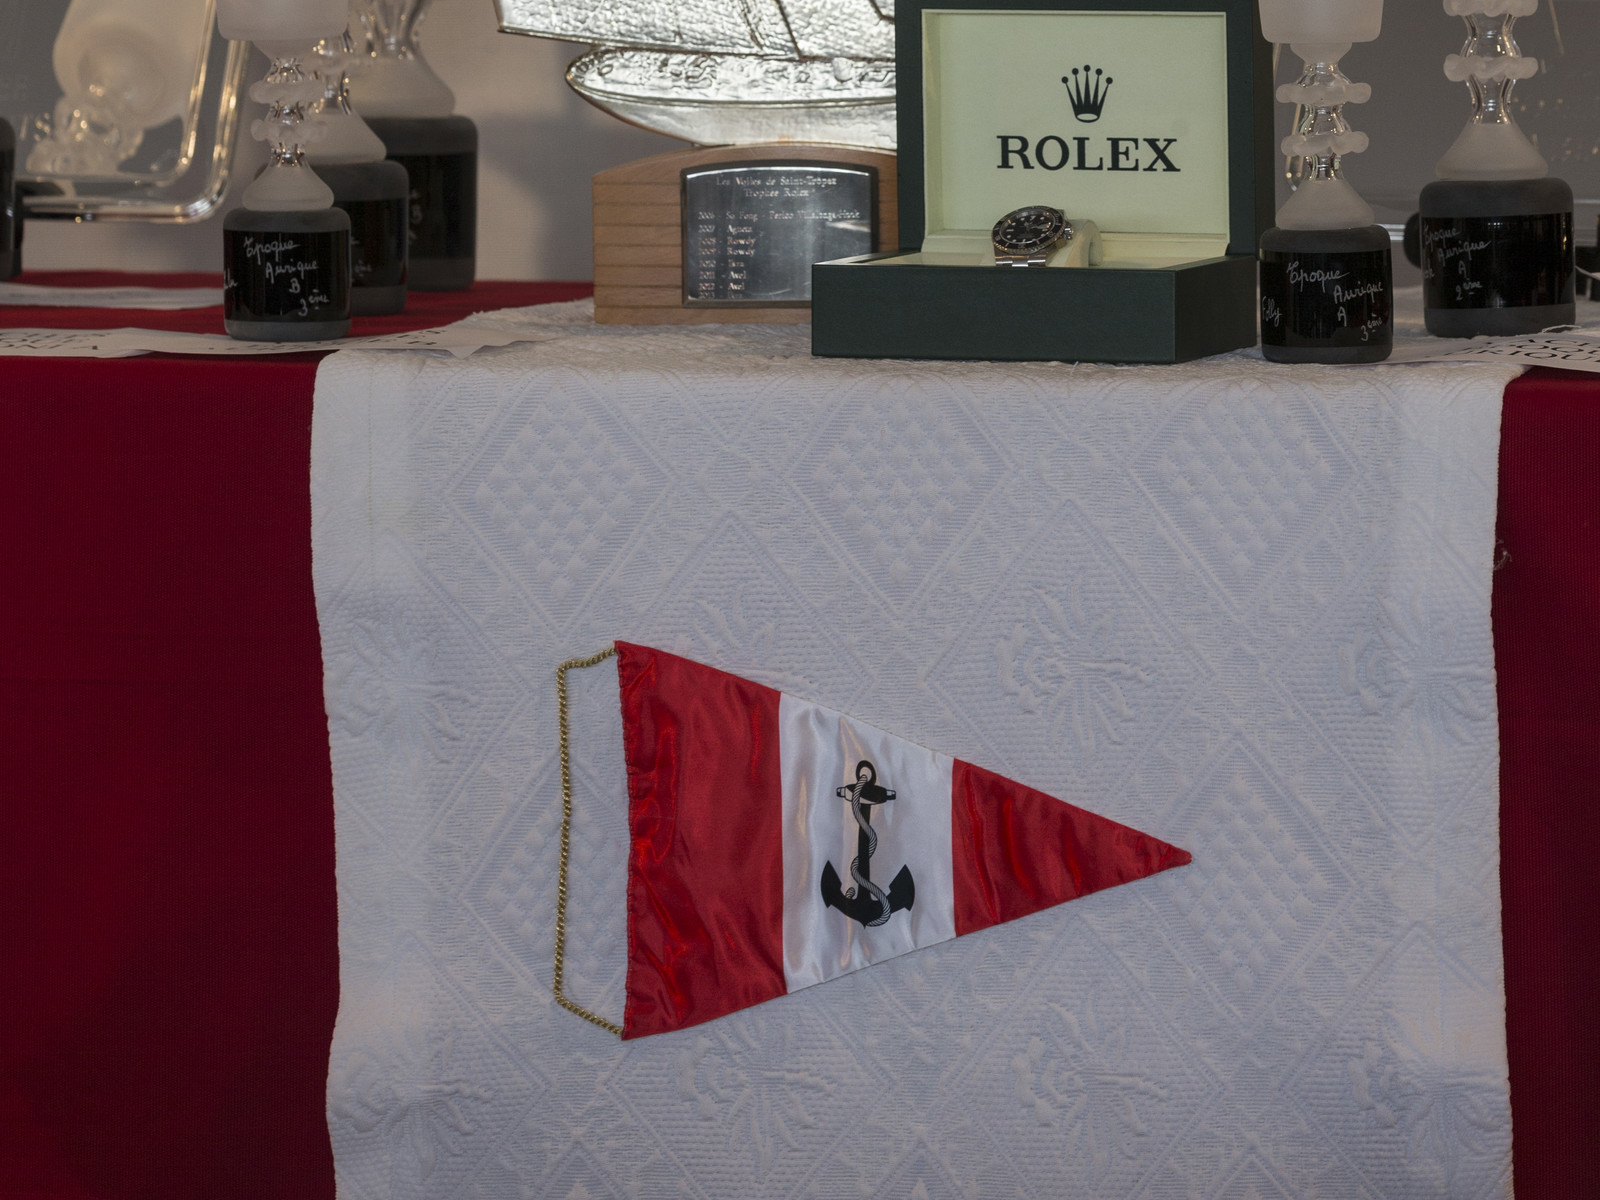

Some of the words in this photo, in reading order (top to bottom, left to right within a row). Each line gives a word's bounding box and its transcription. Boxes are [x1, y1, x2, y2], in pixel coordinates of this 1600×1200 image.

[996, 135, 1181, 172] ROLEX
[288, 277, 301, 294] B
[1337, 305, 1348, 328] A
